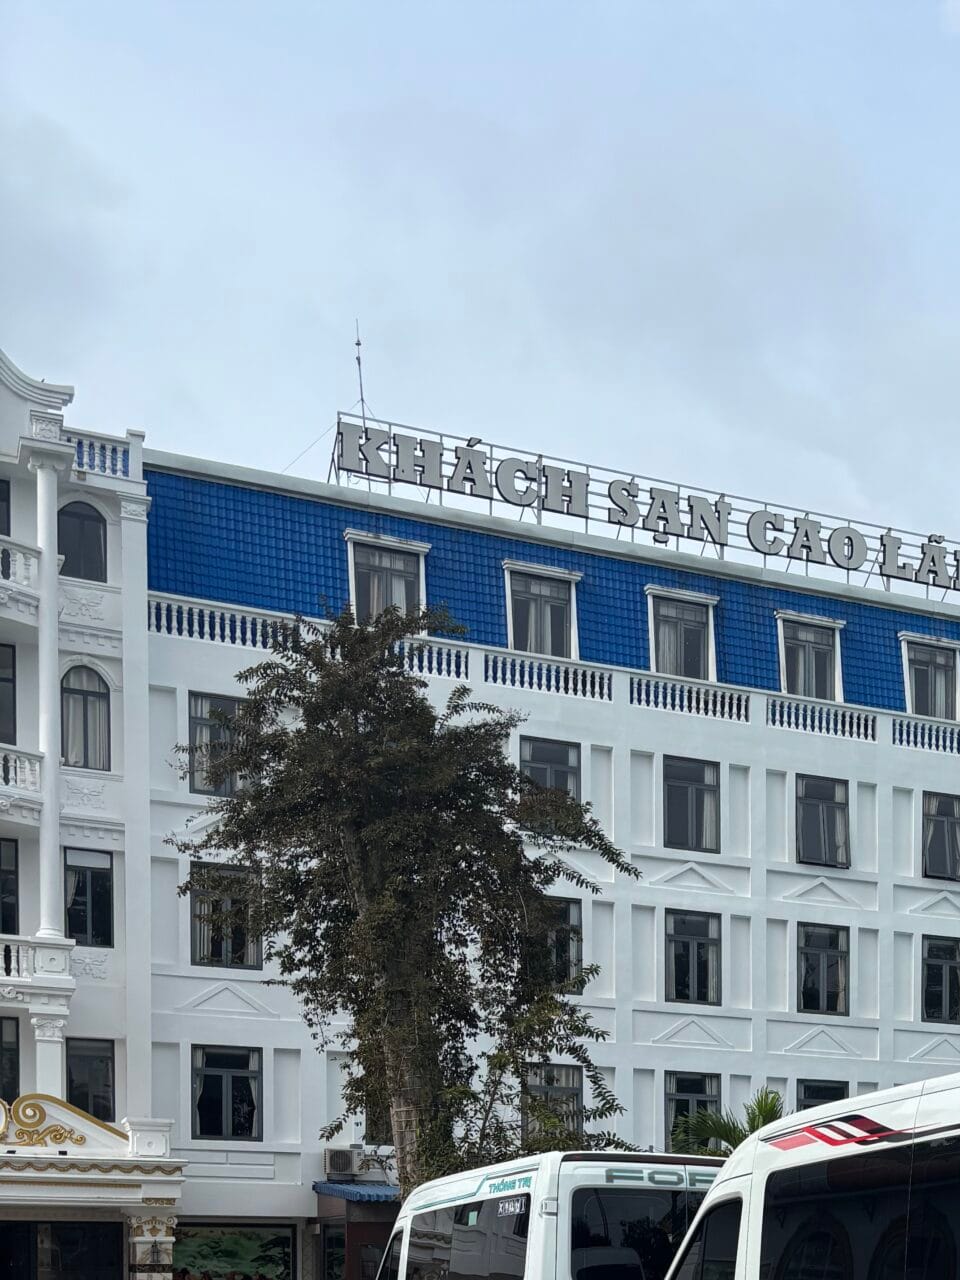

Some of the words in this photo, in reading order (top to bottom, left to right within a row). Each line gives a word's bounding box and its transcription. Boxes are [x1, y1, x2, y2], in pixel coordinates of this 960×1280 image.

[337, 421, 590, 518] KHÁCH
[608, 478, 732, 546] SẠN
[747, 509, 868, 571] CAO
[605, 1168, 721, 1188] FOR
